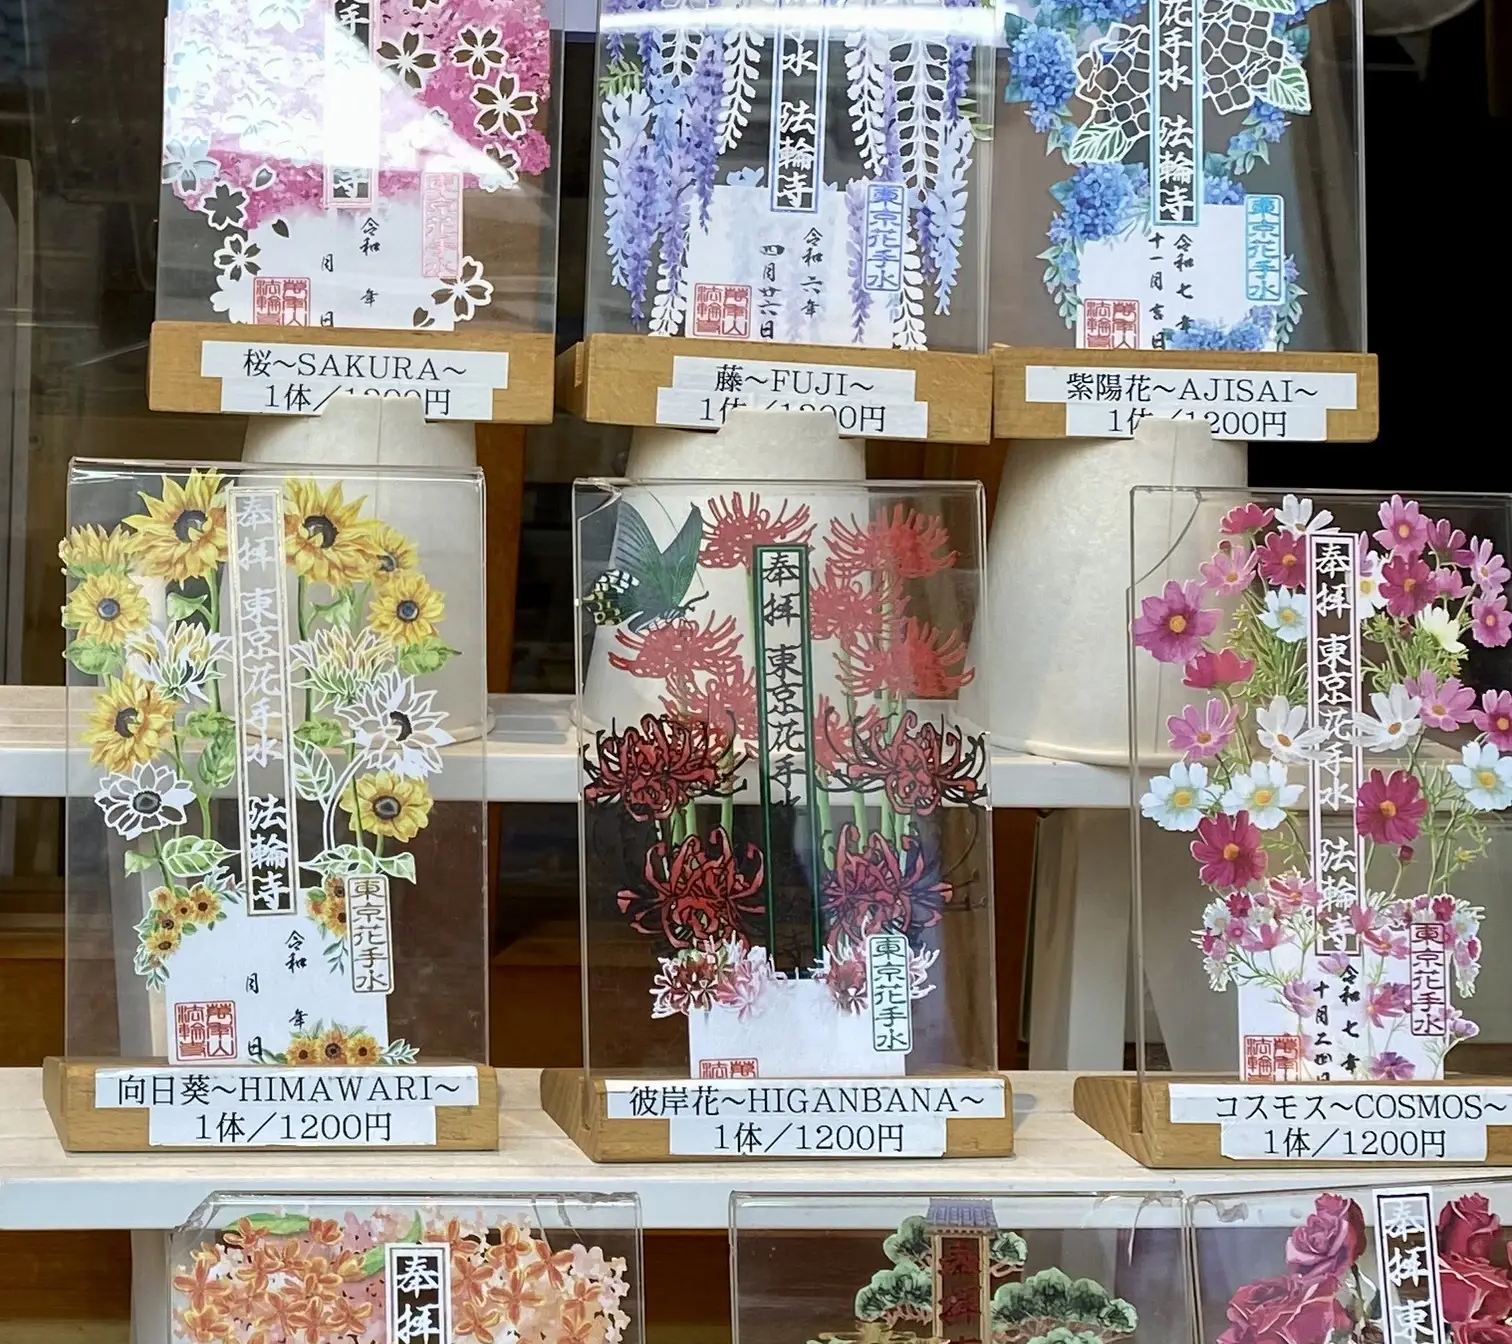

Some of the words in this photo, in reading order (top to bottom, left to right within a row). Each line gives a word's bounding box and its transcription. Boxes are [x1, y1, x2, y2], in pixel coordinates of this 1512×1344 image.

[778, 99, 817, 210] 法輪寺
[1157, 114, 1194, 223] 法輪寺
[866, 184, 906, 292] 東京花手水
[1247, 196, 1283, 301] 東京花手水
[265, 384, 450, 416] 1体／円
[236, 496, 274, 573] 奉拝
[1316, 544, 1351, 619] 奉拝
[761, 552, 801, 628] 奉拝
[241, 586, 285, 770] 東京花手水
[1317, 633, 1356, 811] 東京花手水
[248, 795, 291, 913] 法輪寺
[348, 878, 393, 993] 東京花手水
[1411, 923, 1445, 1035] 東京花手水
[870, 937, 912, 1051] 東京花手水
[195, 1112, 392, 1143] 1体／1200円
[714, 1121, 903, 1154] 1体／1200円
[1264, 1128, 1446, 1158] 1体／1200円
[1385, 1199, 1429, 1287] 奉拝
[397, 1256, 440, 1344] 奉拝
